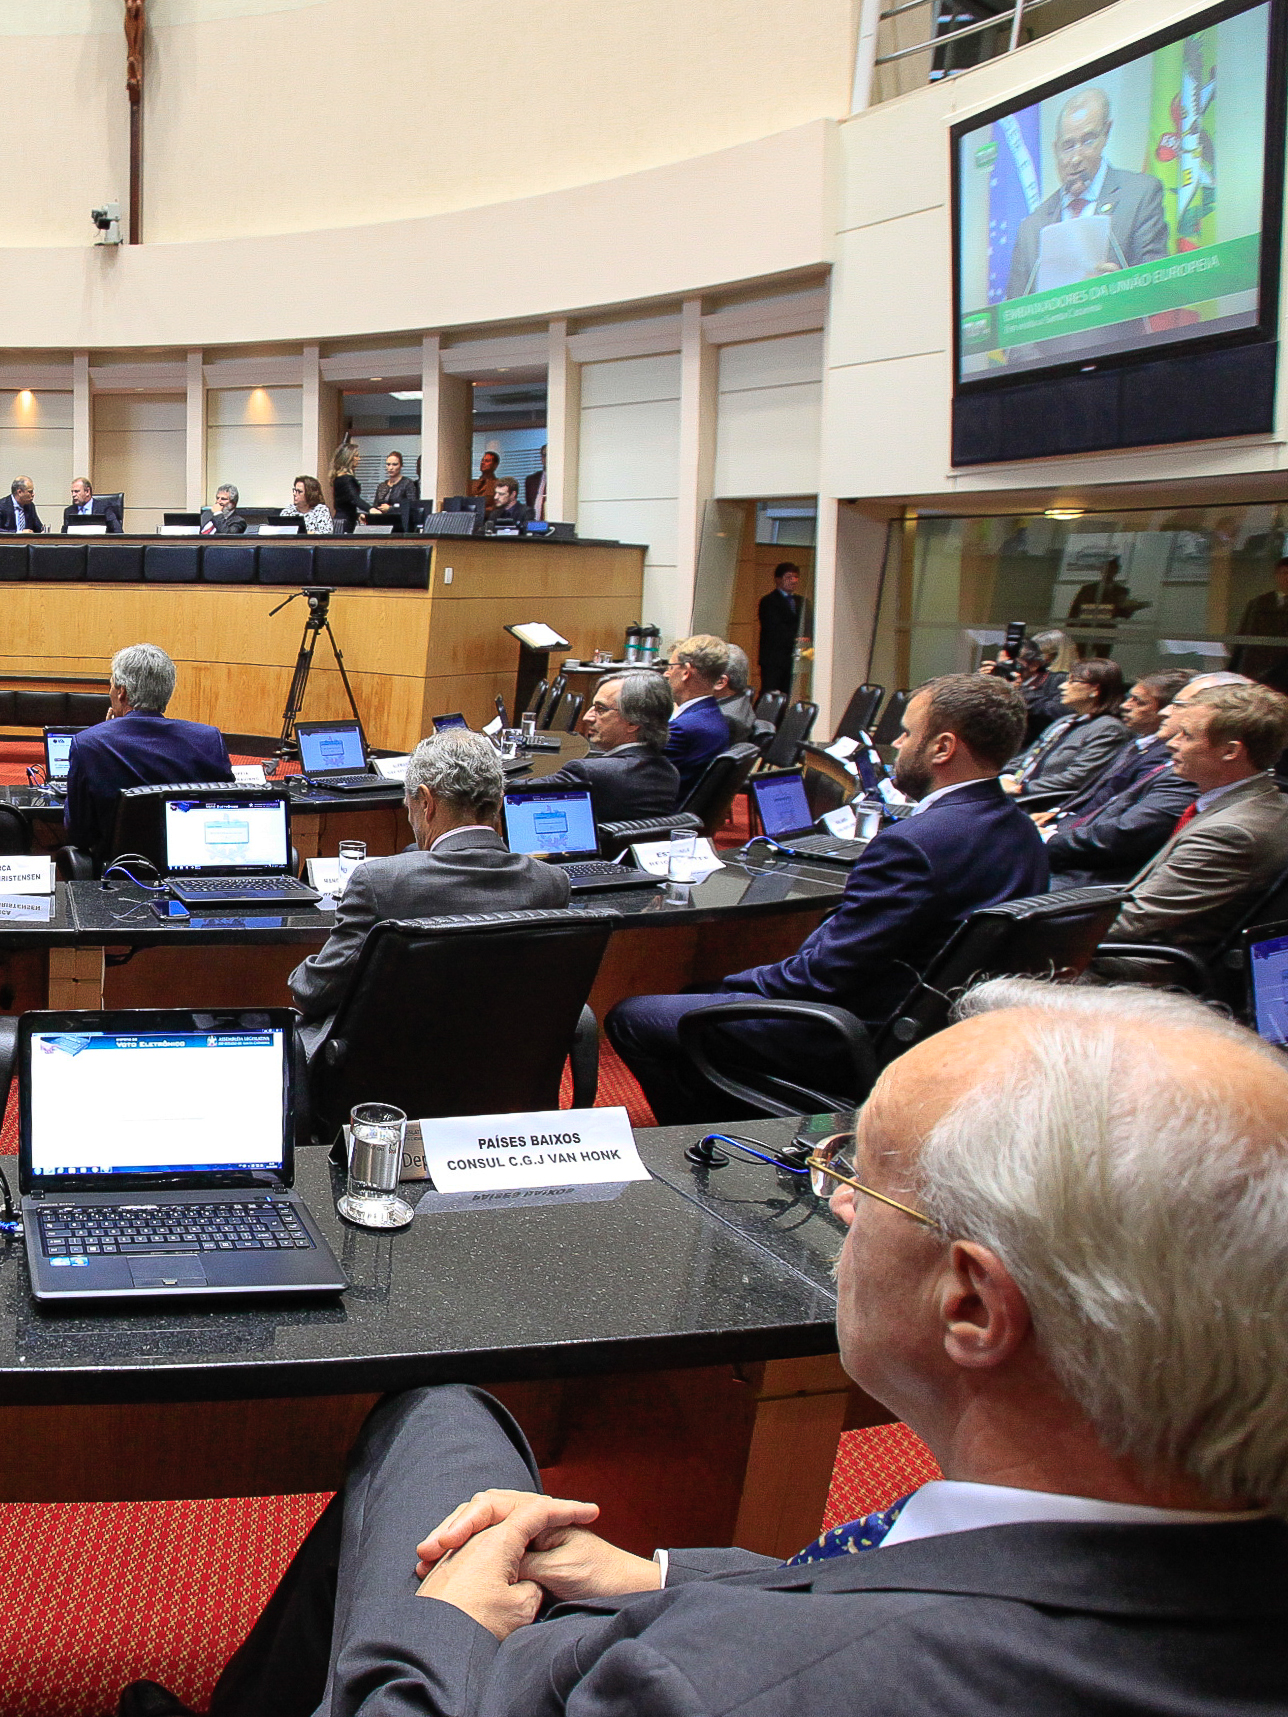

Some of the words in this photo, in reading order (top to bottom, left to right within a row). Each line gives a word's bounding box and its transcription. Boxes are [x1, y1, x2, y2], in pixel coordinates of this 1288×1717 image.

[477, 1133, 527, 1150] PAÍSES
[530, 1132, 581, 1147] BAIXOS
[447, 1157, 506, 1171] CONSUL
[508, 1154, 546, 1168] C.G.J
[550, 1152, 578, 1165] VAN
[582, 1149, 622, 1162] HONK
